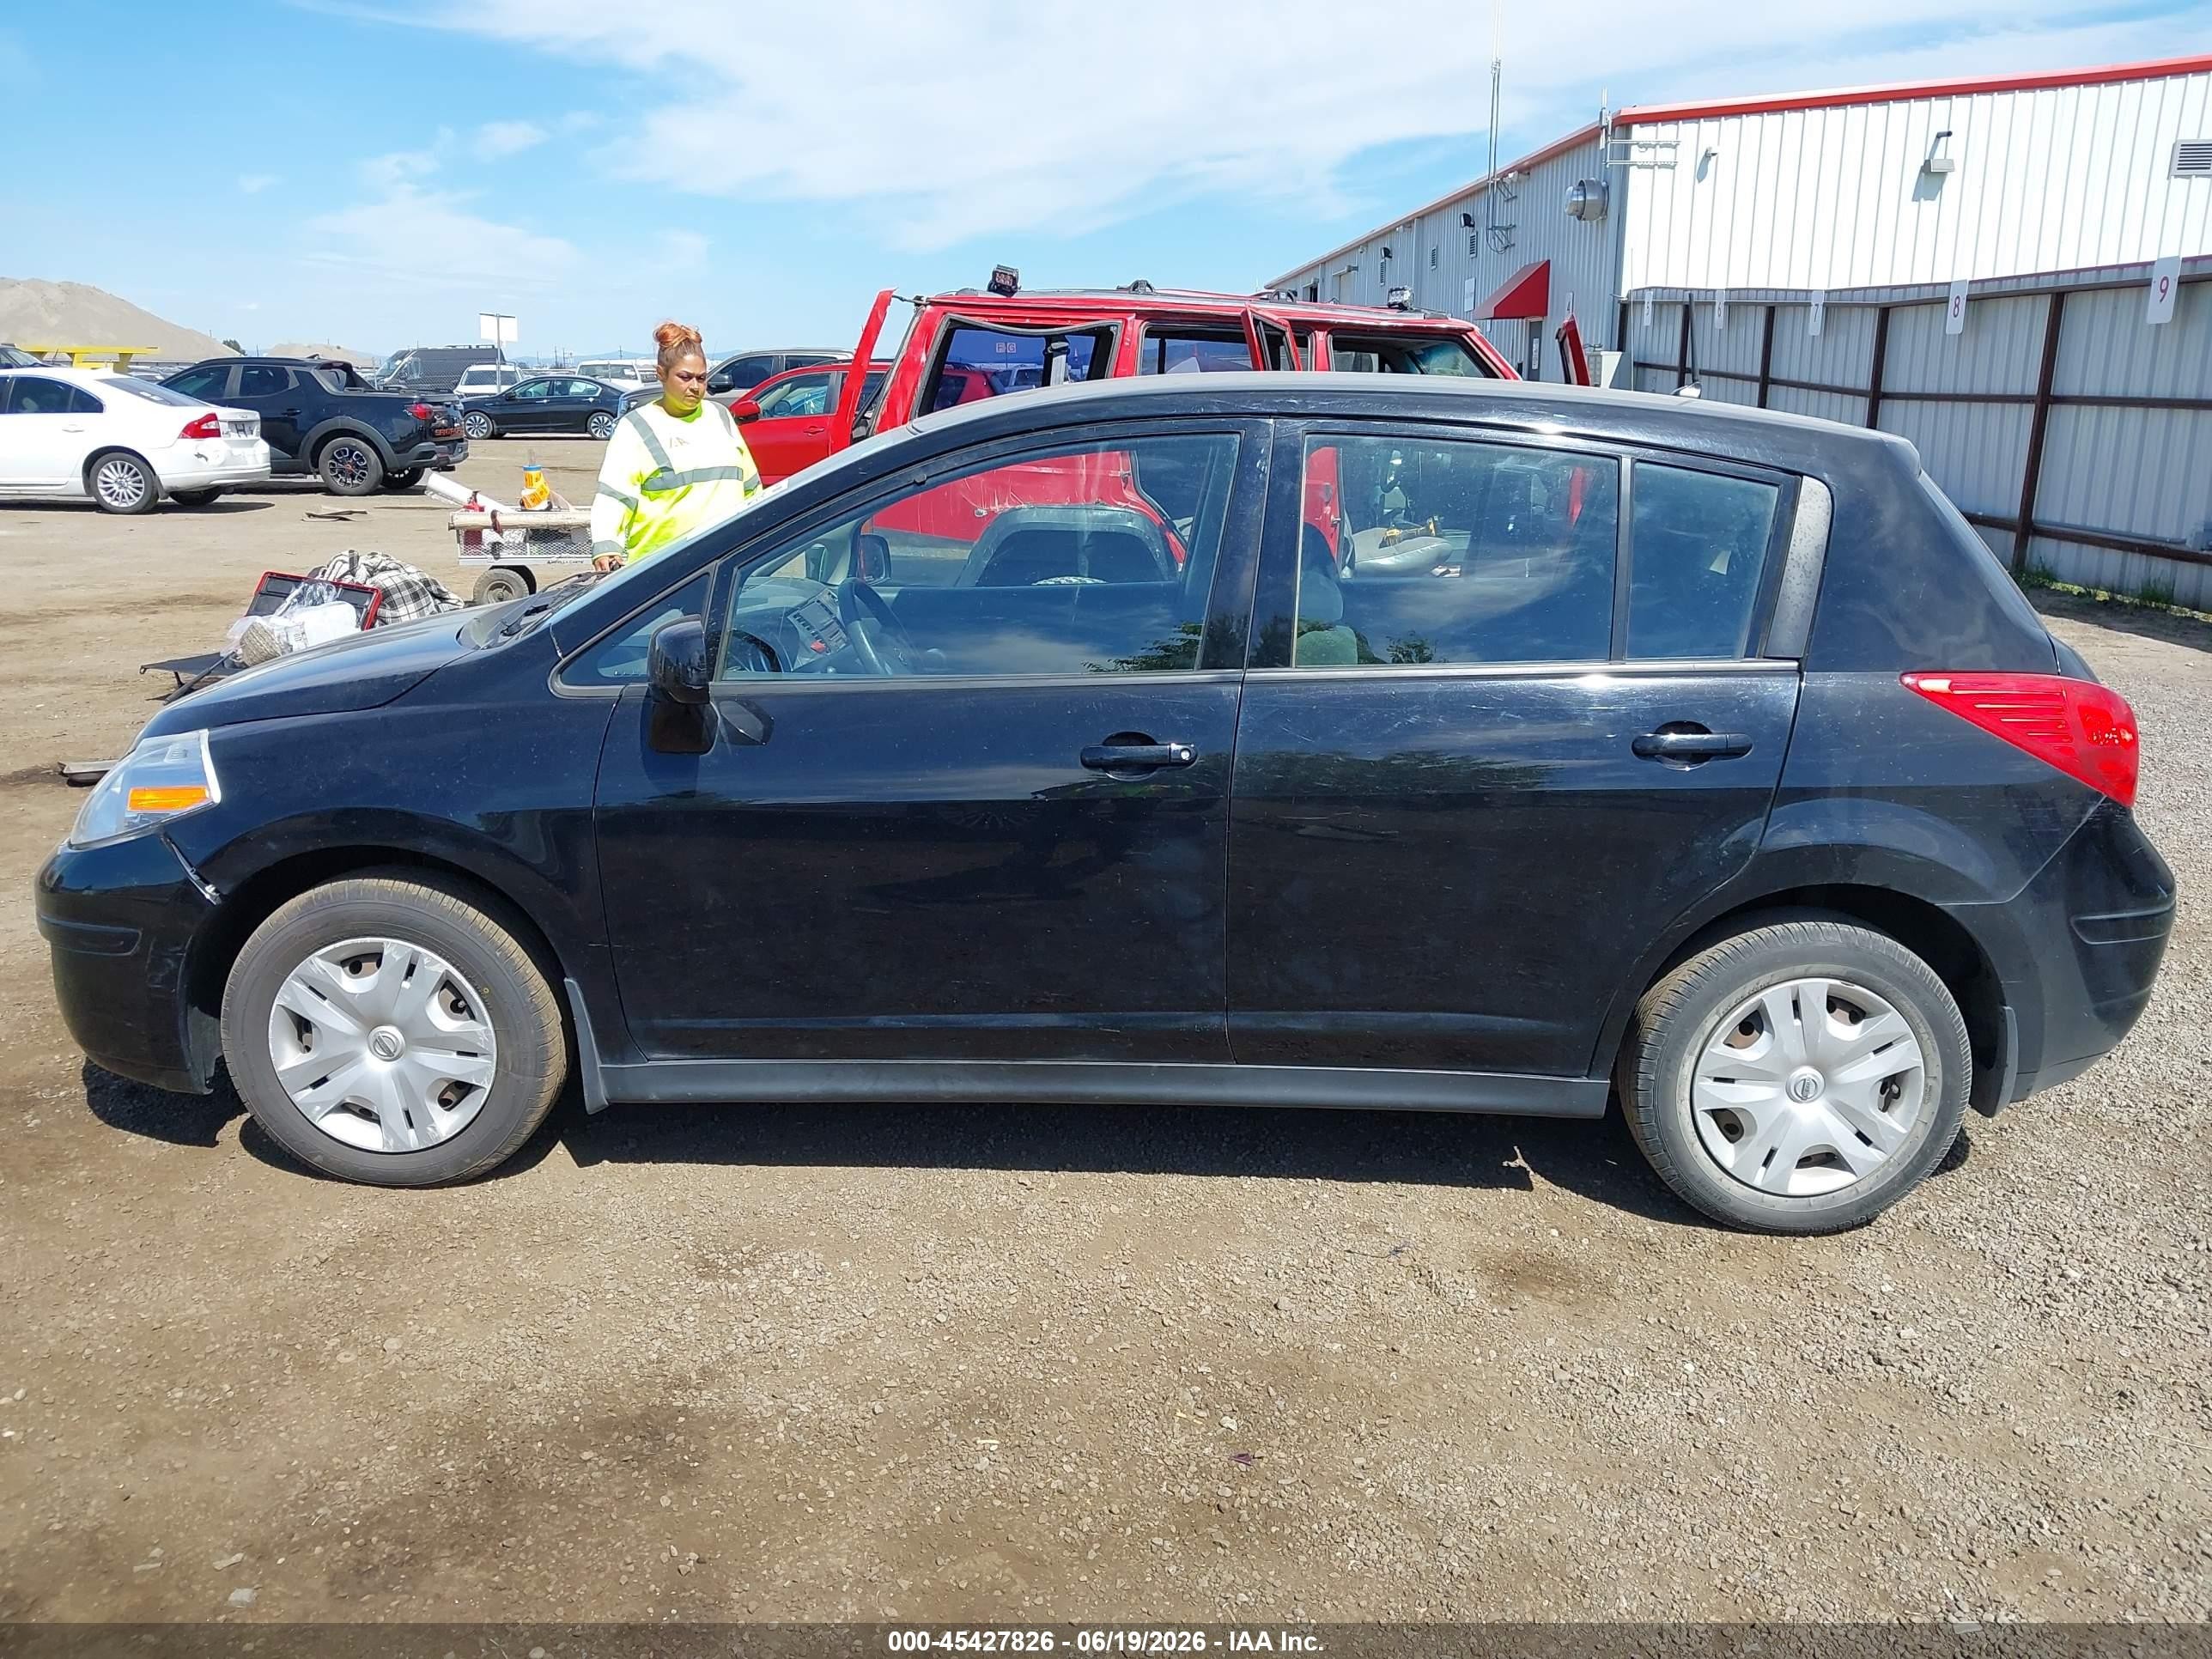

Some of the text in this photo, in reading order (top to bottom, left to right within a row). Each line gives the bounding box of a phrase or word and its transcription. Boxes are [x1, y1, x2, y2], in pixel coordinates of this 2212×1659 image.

[2160, 276, 2170, 303] 9
[1717, 301, 1722, 317] 6
[1814, 303, 1820, 323] 7
[1953, 295, 1961, 319] 8
